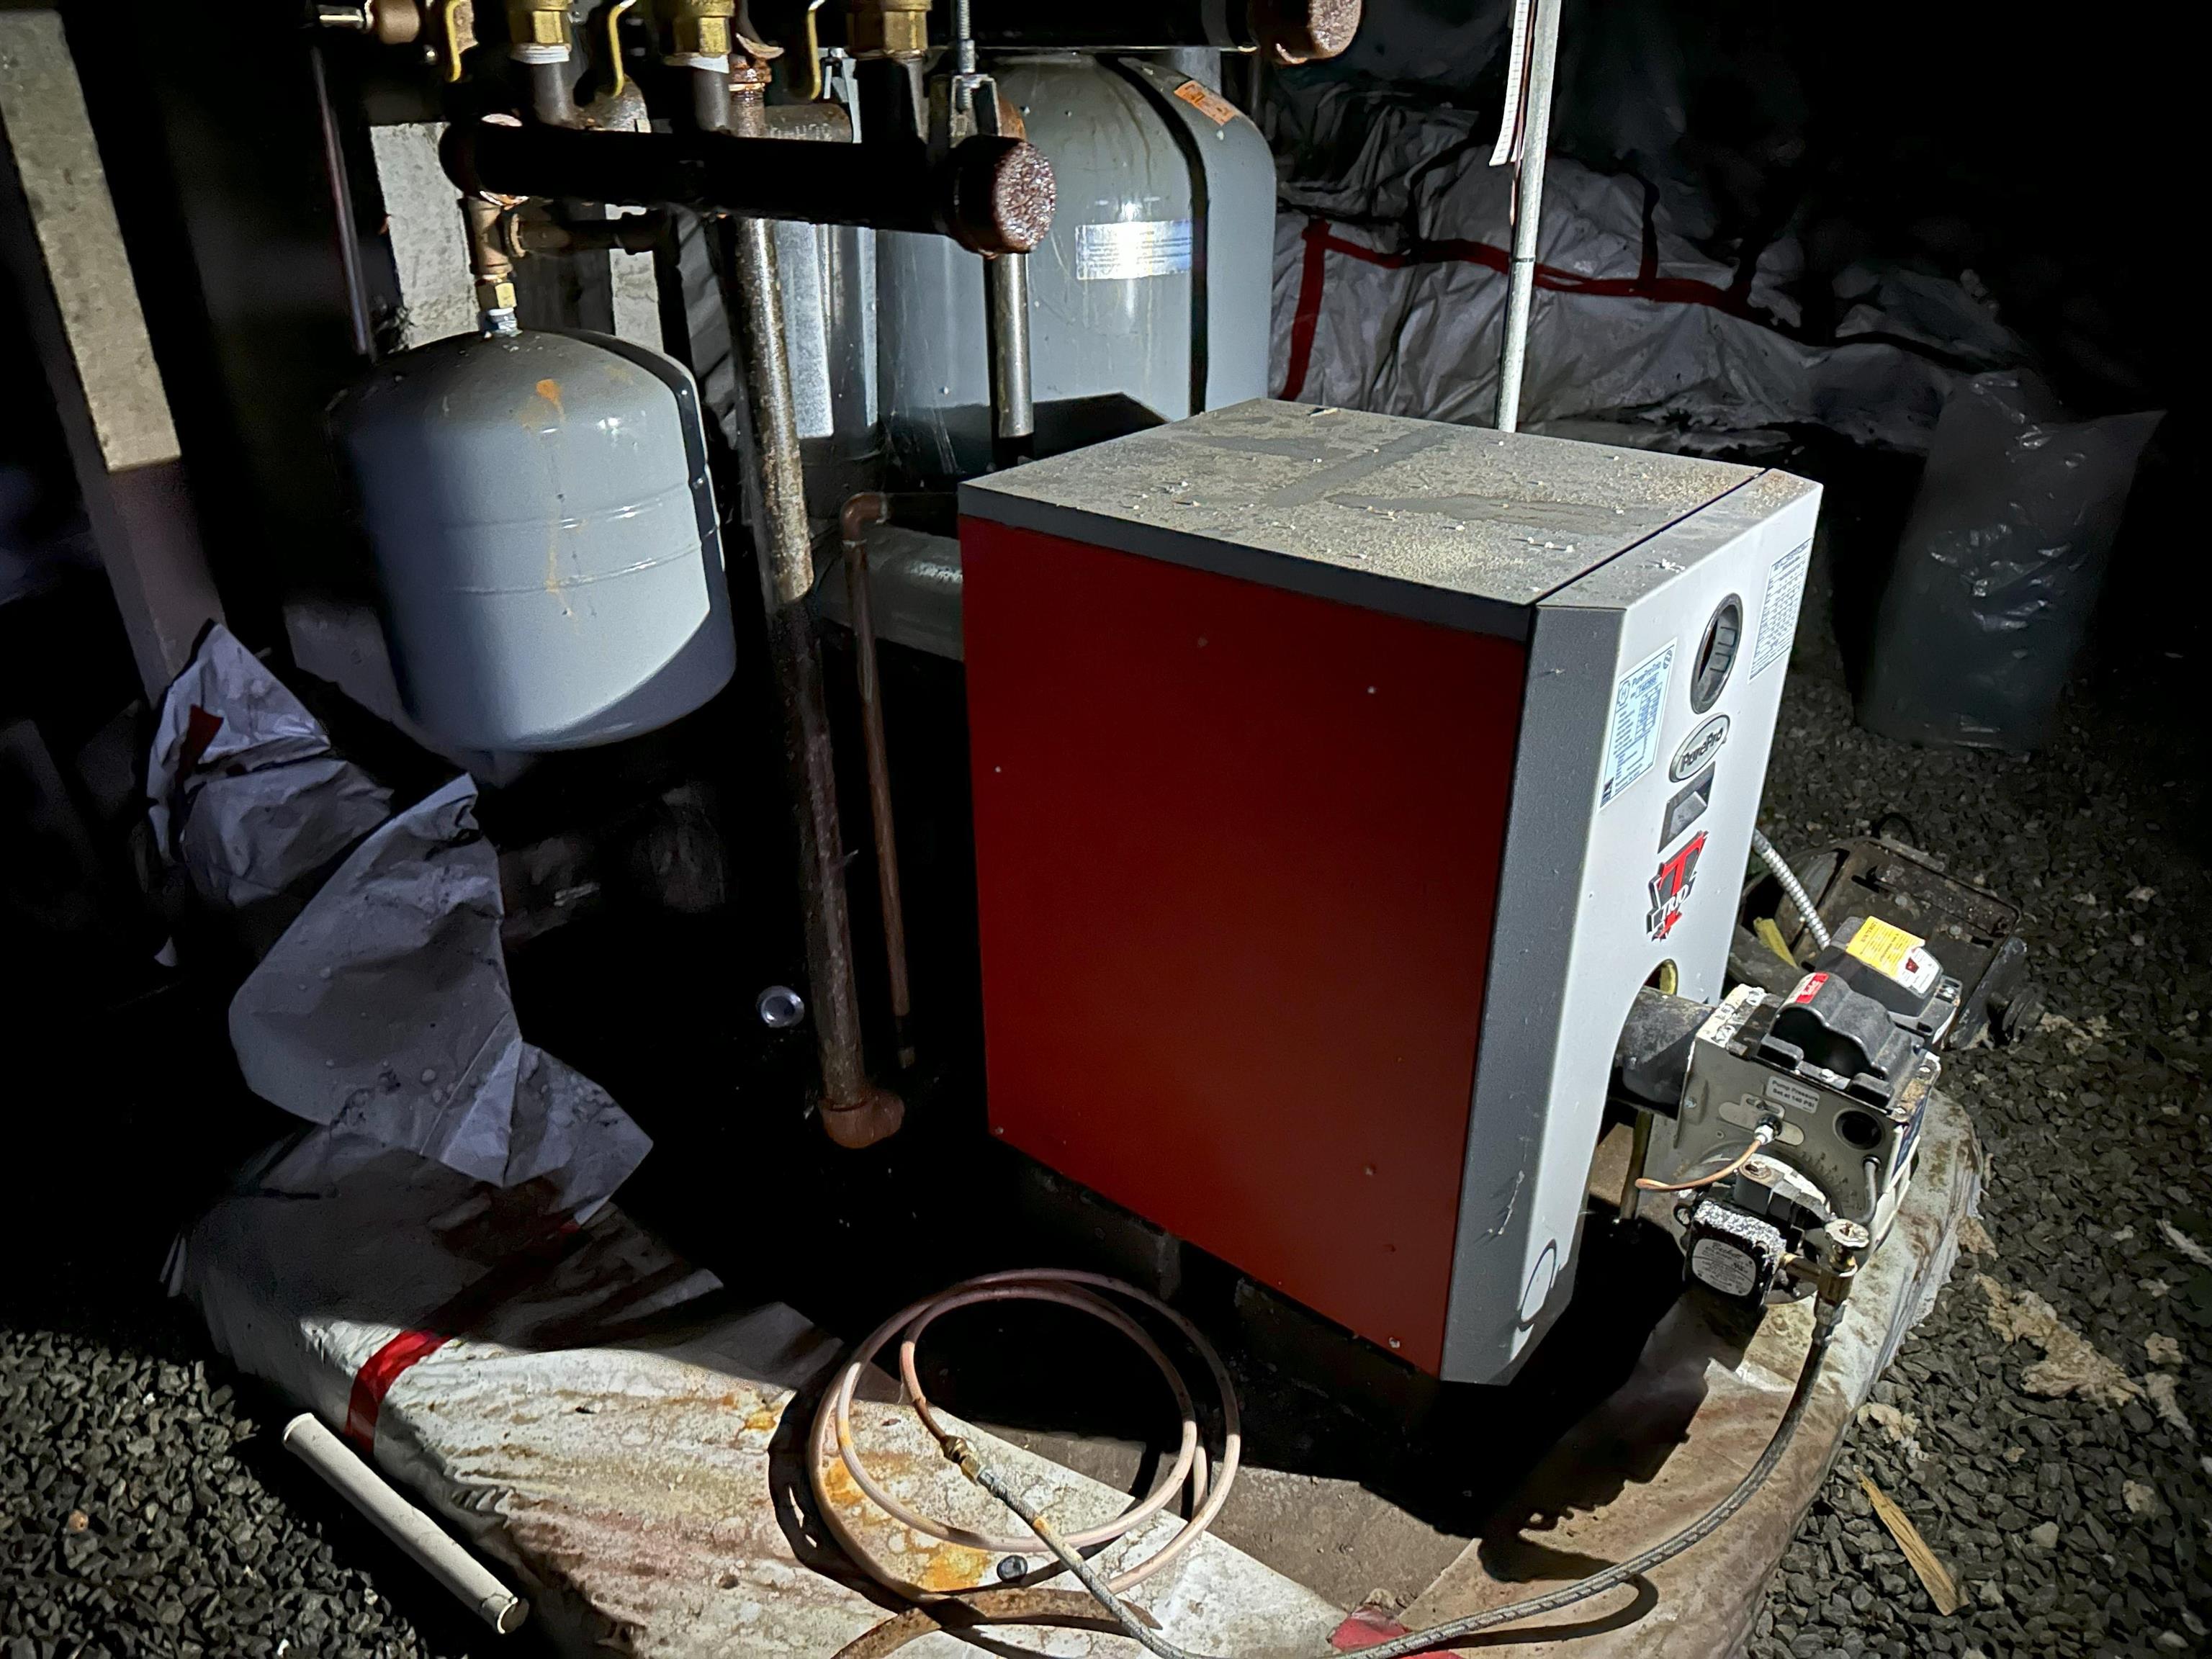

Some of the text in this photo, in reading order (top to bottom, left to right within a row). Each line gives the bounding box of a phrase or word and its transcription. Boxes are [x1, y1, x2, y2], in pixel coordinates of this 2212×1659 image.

[1680, 727, 1723, 773] PurePro
[1660, 884, 1690, 922] TRIO
[1772, 1080, 1819, 1102] Pump Pressure
